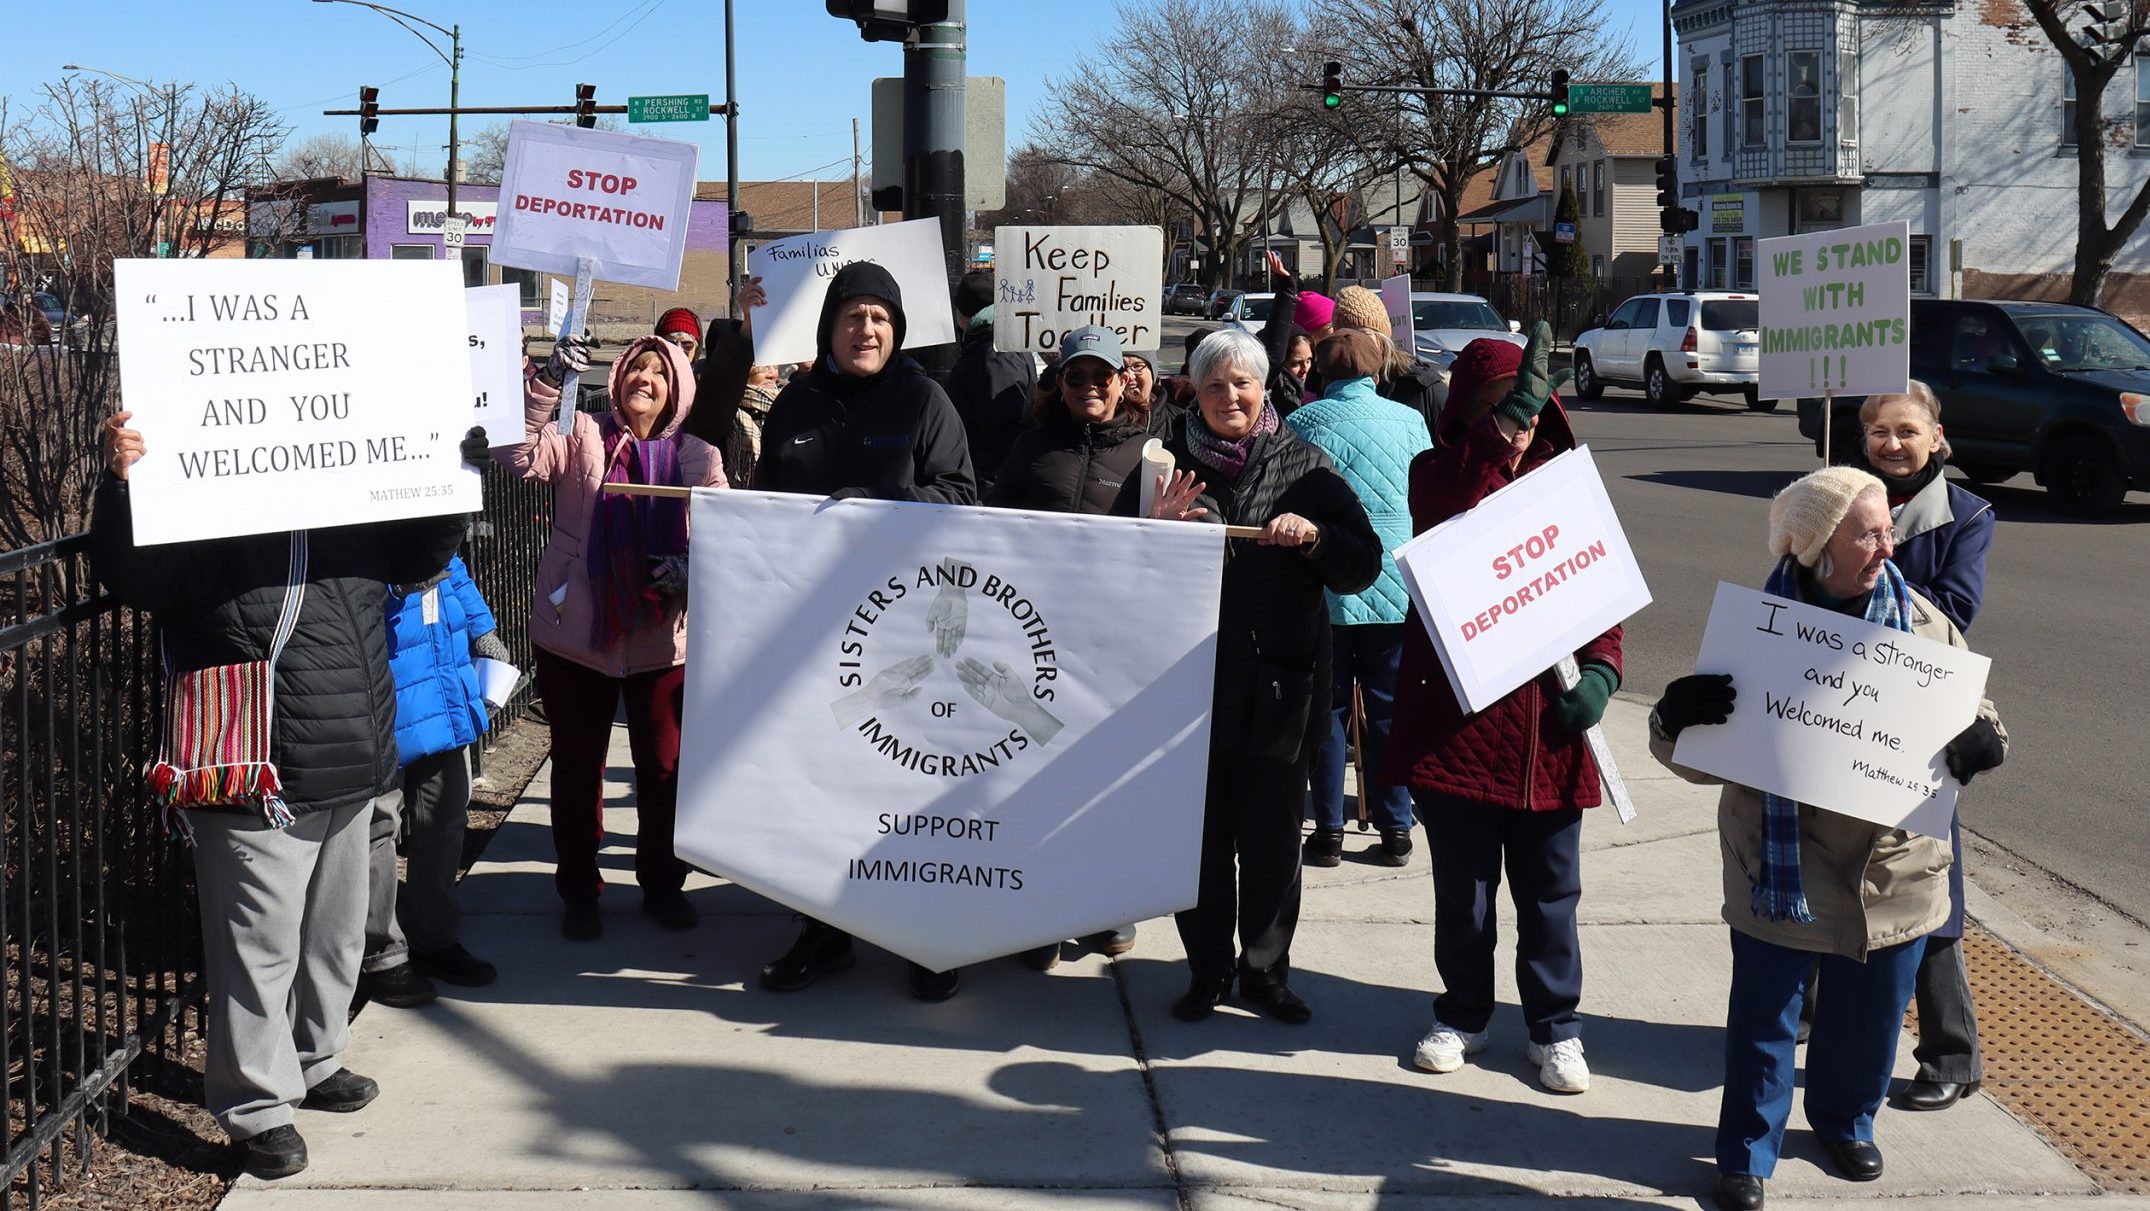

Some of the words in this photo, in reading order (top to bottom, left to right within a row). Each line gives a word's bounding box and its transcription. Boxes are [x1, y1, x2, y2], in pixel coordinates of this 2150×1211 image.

[644, 98, 689, 106] PERSHING
[1584, 96, 1632, 104] ROCKWELL
[1589, 87, 1626, 95] ARCHER
[643, 106, 690, 114] ROCKWELL
[567, 169, 637, 195] STOP
[447, 219, 464, 227] SPEED
[515, 194, 665, 231] DEPORTATION
[446, 232, 462, 243] 30
[766, 241, 840, 262] Familias
[1393, 238, 1406, 247] 30
[1025, 231, 1110, 278] Keep
[1773, 251, 1803, 277] WE
[1816, 237, 1902, 272] STAND
[209, 294, 279, 322] WAS
[290, 294, 310, 321] A
[1057, 277, 1146, 312] Families
[1803, 281, 1864, 312] WITH
[1762, 318, 1905, 354] IMMIGRANTS
[189, 342, 351, 377] STRANGER
[200, 398, 267, 428] AND
[290, 394, 351, 423] YOU
[178, 440, 357, 480] WELCOMED
[370, 486, 422, 503] MATHEW
[425, 484, 454, 499] 25:35
[1492, 524, 1560, 580] STOP
[1460, 540, 1607, 642] DEPORTATION
[839, 576, 907, 687] SISTERS
[916, 564, 978, 589] AND
[981, 574, 1058, 702] BROTHERS
[1756, 600, 1788, 636] I
[1796, 622, 1844, 650] was
[1852, 642, 1867, 660] a
[1804, 666, 1845, 690] and
[1843, 680, 1879, 707] you
[931, 701, 957, 718] OF
[1765, 691, 1863, 740] Welcomed
[858, 717, 1029, 777] IMMIGRANTS
[1852, 759, 1905, 786] Matthew
[877, 813, 1000, 841] SUPPORT
[849, 859, 1024, 890] IMMIGRANTS
